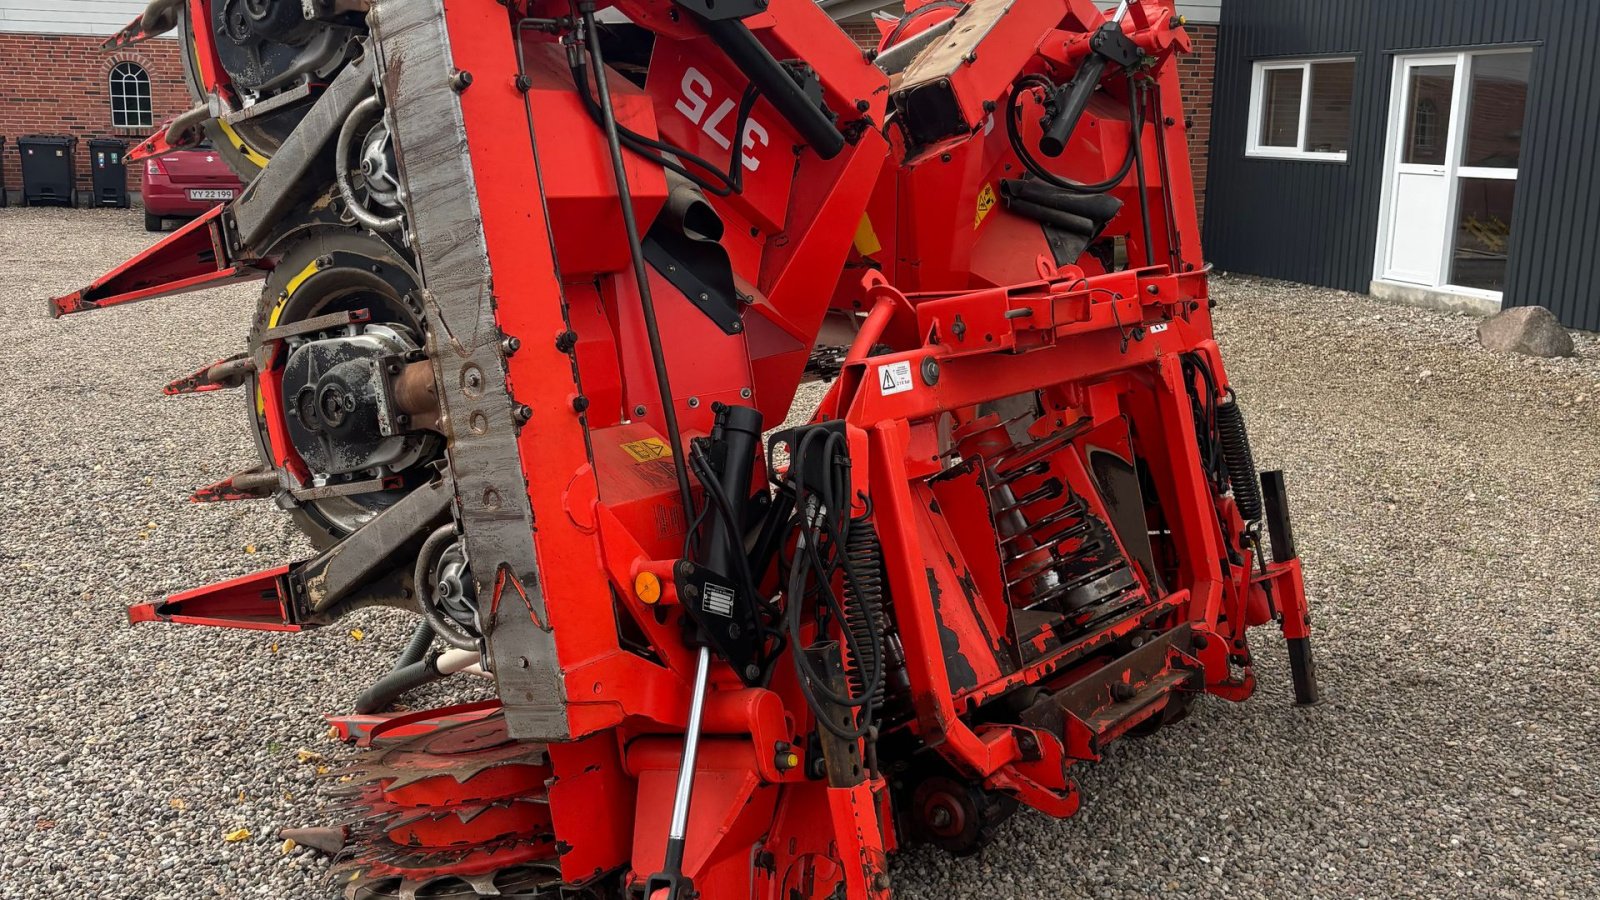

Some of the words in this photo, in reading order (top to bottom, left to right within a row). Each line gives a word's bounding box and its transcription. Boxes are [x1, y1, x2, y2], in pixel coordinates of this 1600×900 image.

[674, 66, 769, 172] 375
[192, 190, 203, 198] YY
[205, 190, 215, 198] 22
[217, 190, 231, 198] 199
